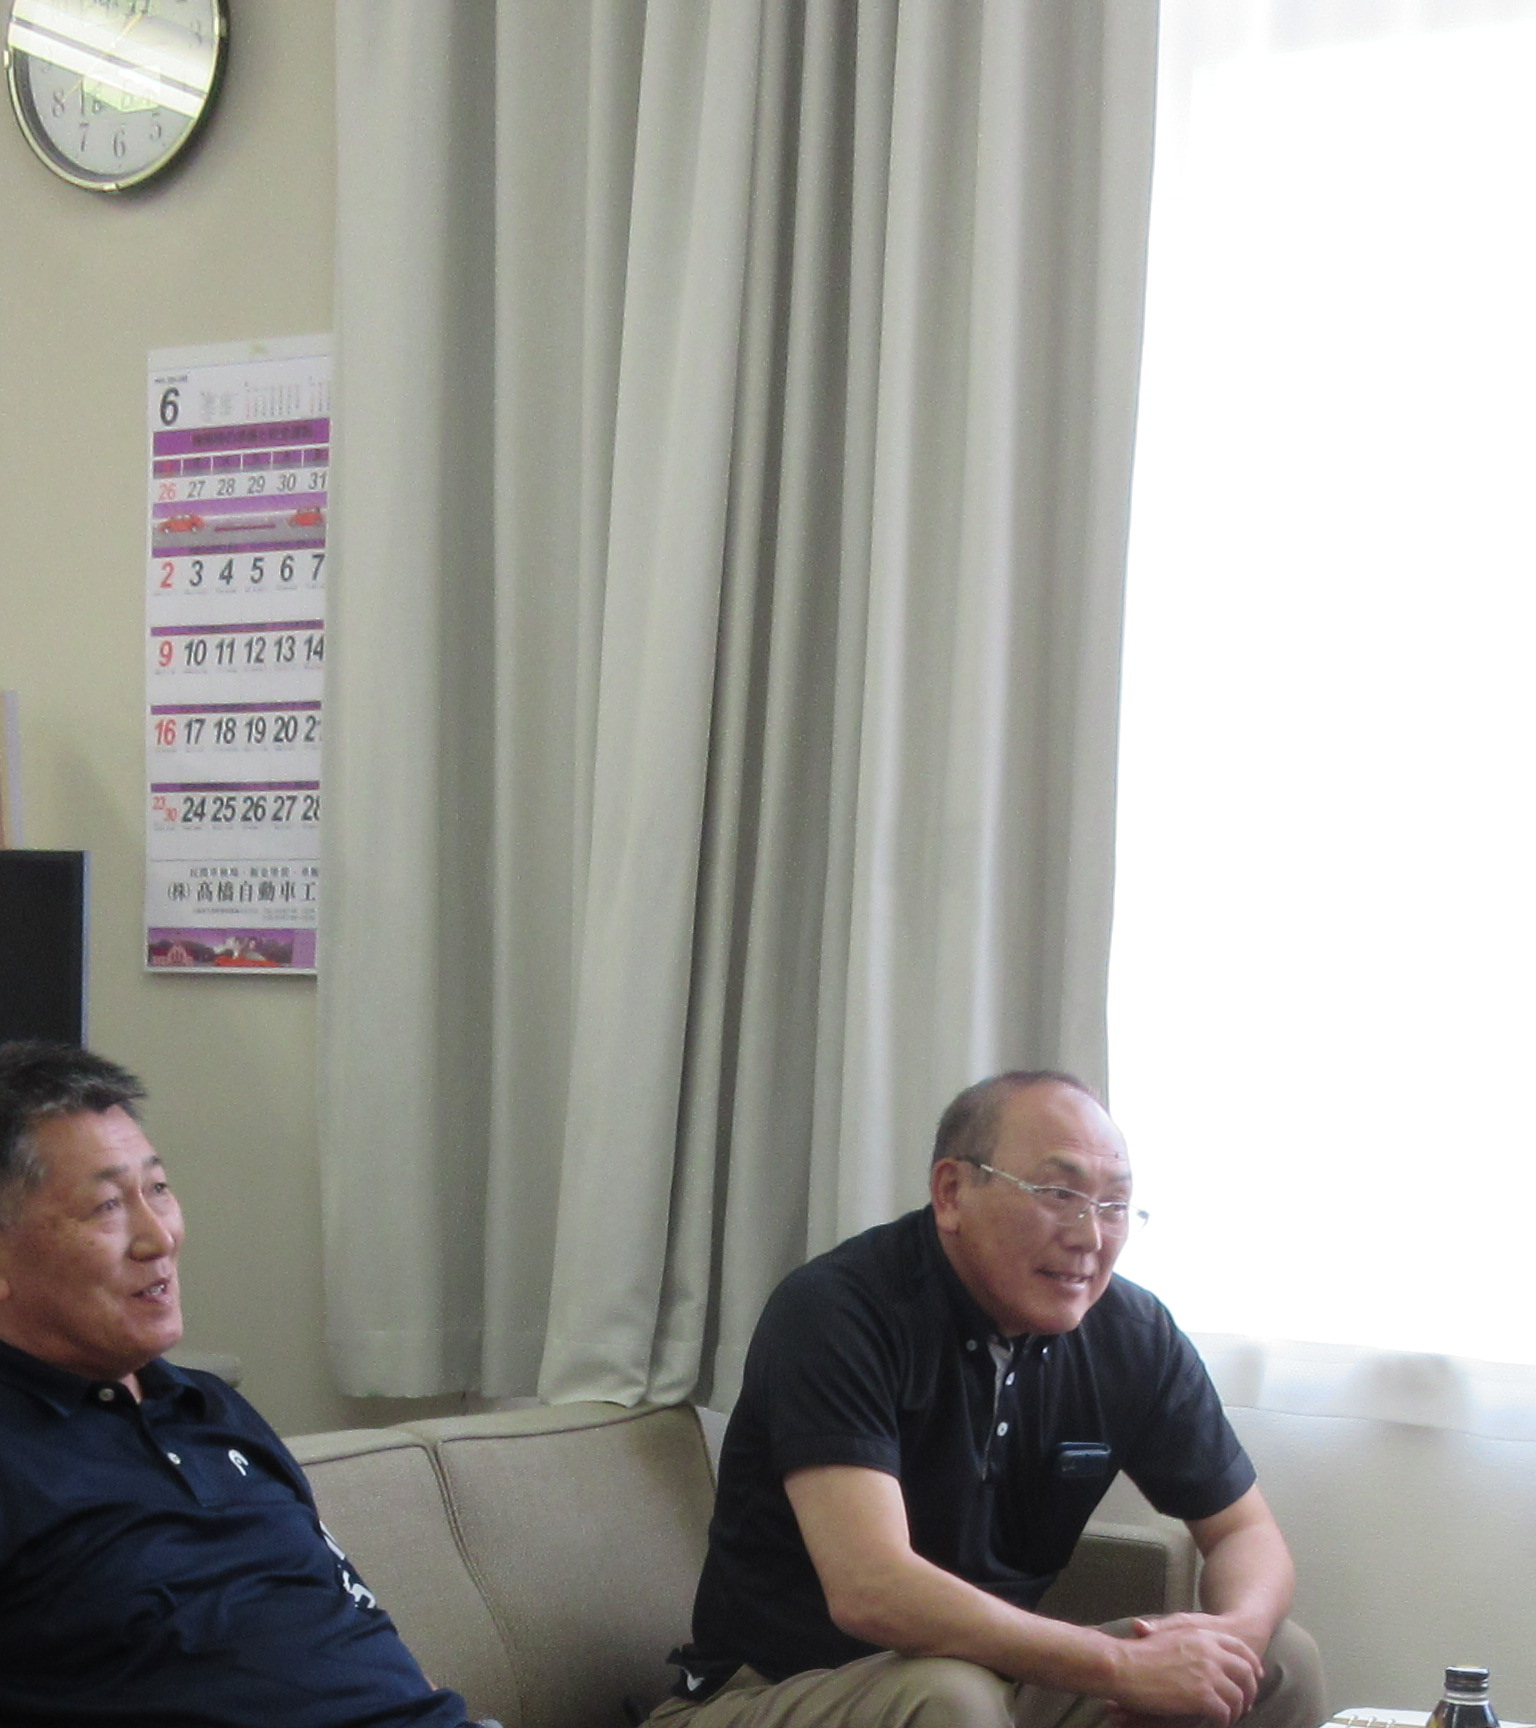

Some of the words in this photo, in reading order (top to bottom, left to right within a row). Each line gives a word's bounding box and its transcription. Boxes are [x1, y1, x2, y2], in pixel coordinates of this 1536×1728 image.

[51, 88, 66, 118] 8
[79, 122, 90, 153] 7
[113, 130, 126, 158] 6
[159, 387, 180, 426] 6
[158, 482, 177, 501] 26
[187, 481, 206, 498] 27
[216, 479, 236, 496] 28
[246, 475, 266, 494] 29
[276, 474, 297, 492] 30
[308, 472, 327, 490] 31
[161, 562, 175, 589] 2
[190, 560, 204, 587] 3
[219, 559, 234, 585] 4
[250, 557, 264, 584] 5
[280, 555, 295, 582] 6
[311, 554, 325, 581] 7
[158, 641, 173, 667] 9
[184, 640, 207, 666] 10
[215, 638, 235, 665] 11
[244, 637, 265, 664] 12
[274, 636, 296, 663] 13
[304, 635, 324, 662] 14
[154, 719, 177, 746] 16
[184, 718, 206, 745] 17
[213, 717, 237, 744] 18
[244, 716, 266, 744] 19
[272, 715, 297, 743] 20
[182, 796, 206, 823] 24
[210, 795, 236, 822] 25
[240, 795, 266, 822] 26
[271, 794, 297, 821] 27
